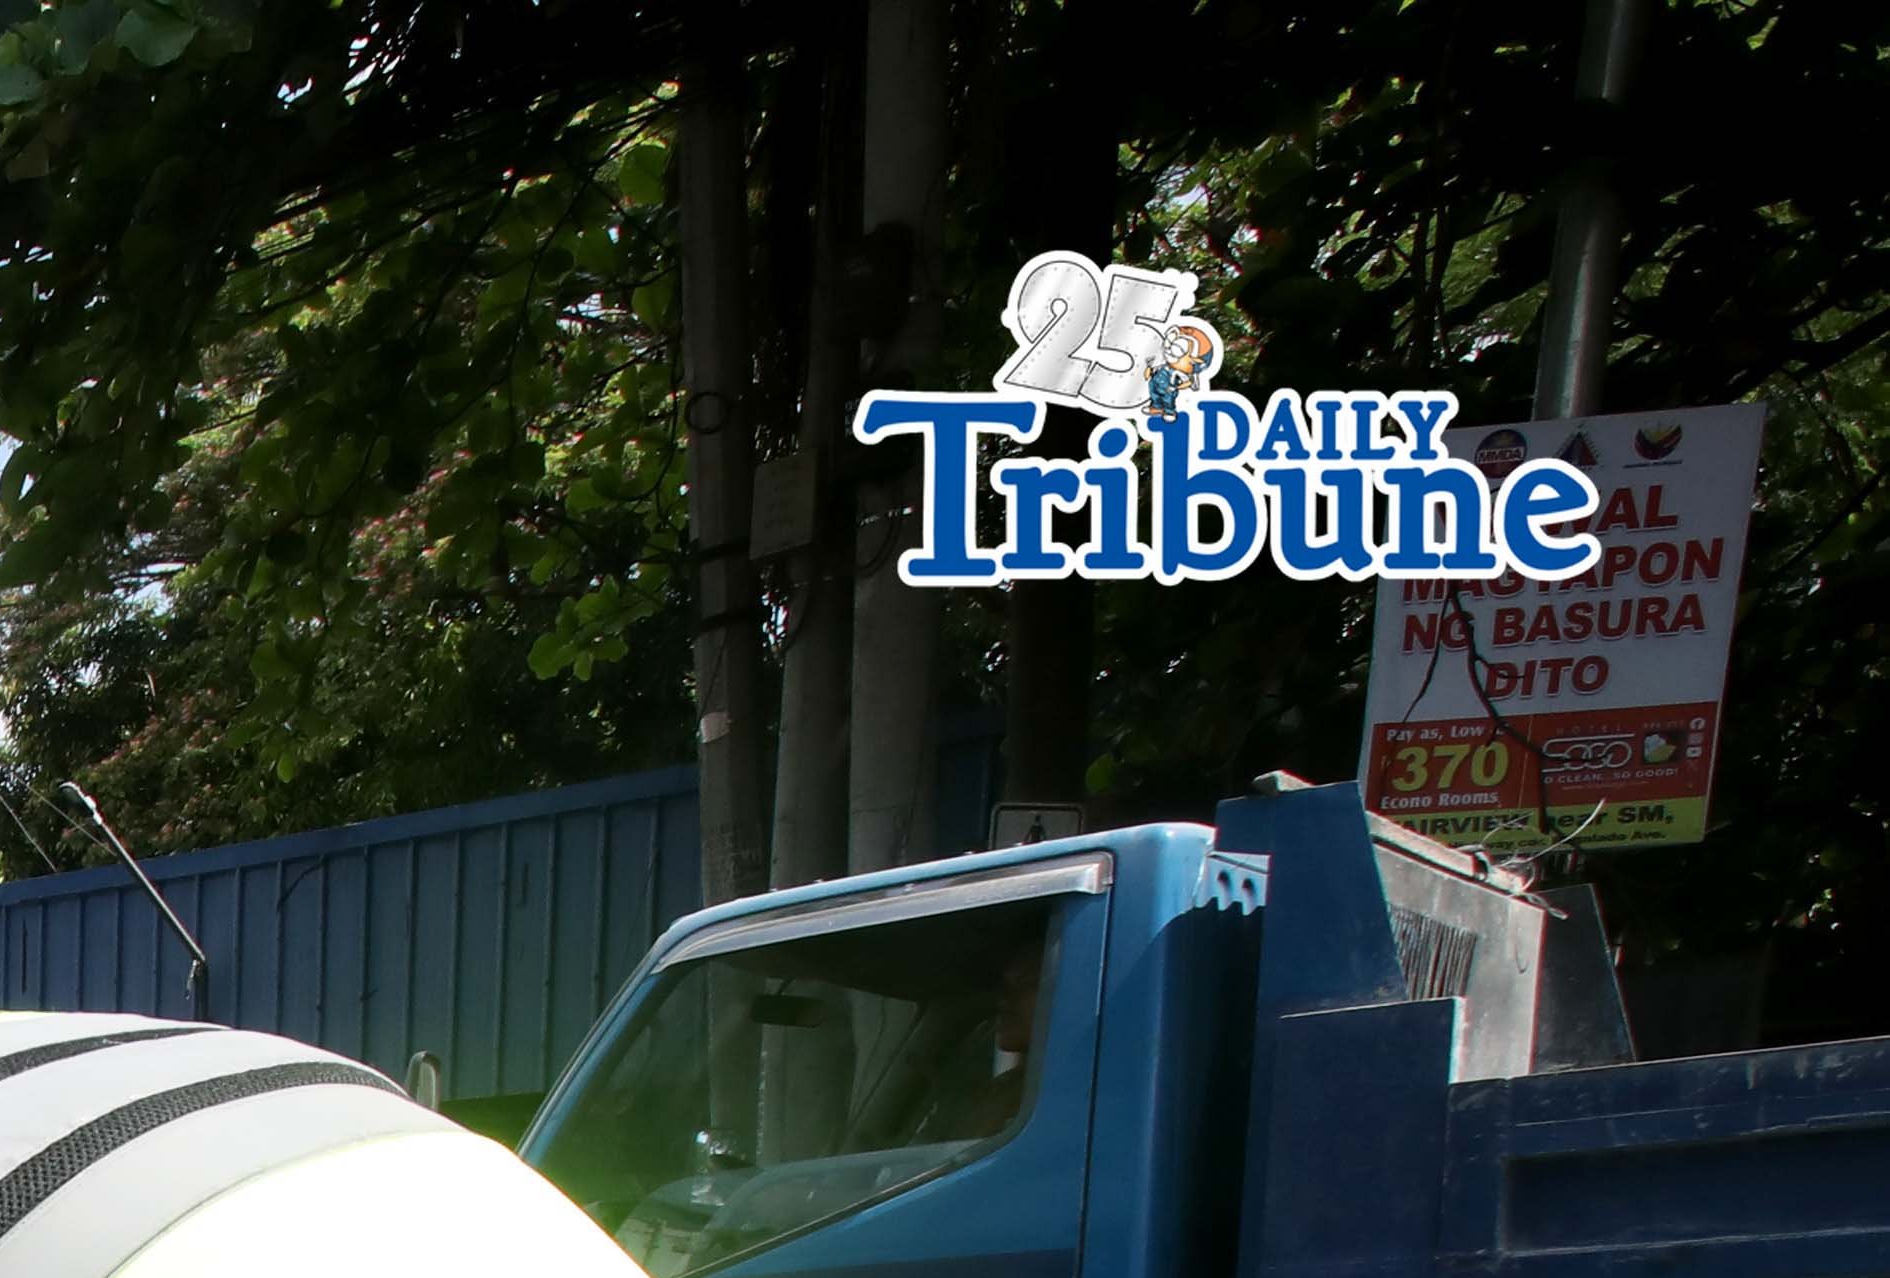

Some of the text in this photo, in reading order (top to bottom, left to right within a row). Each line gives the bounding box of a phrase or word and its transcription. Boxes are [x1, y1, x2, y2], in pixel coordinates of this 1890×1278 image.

[1402, 536, 1724, 603] MAGAPON
[1403, 593, 1708, 653] NG BASURA
[1485, 655, 1610, 700] DITO
[1386, 726, 1414, 743] Pay
[1450, 724, 1484, 739] Low
[1391, 741, 1509, 792] 370
[1380, 791, 1500, 810] Econo Rooms
[1395, 811, 1530, 836] AIRVIEW
